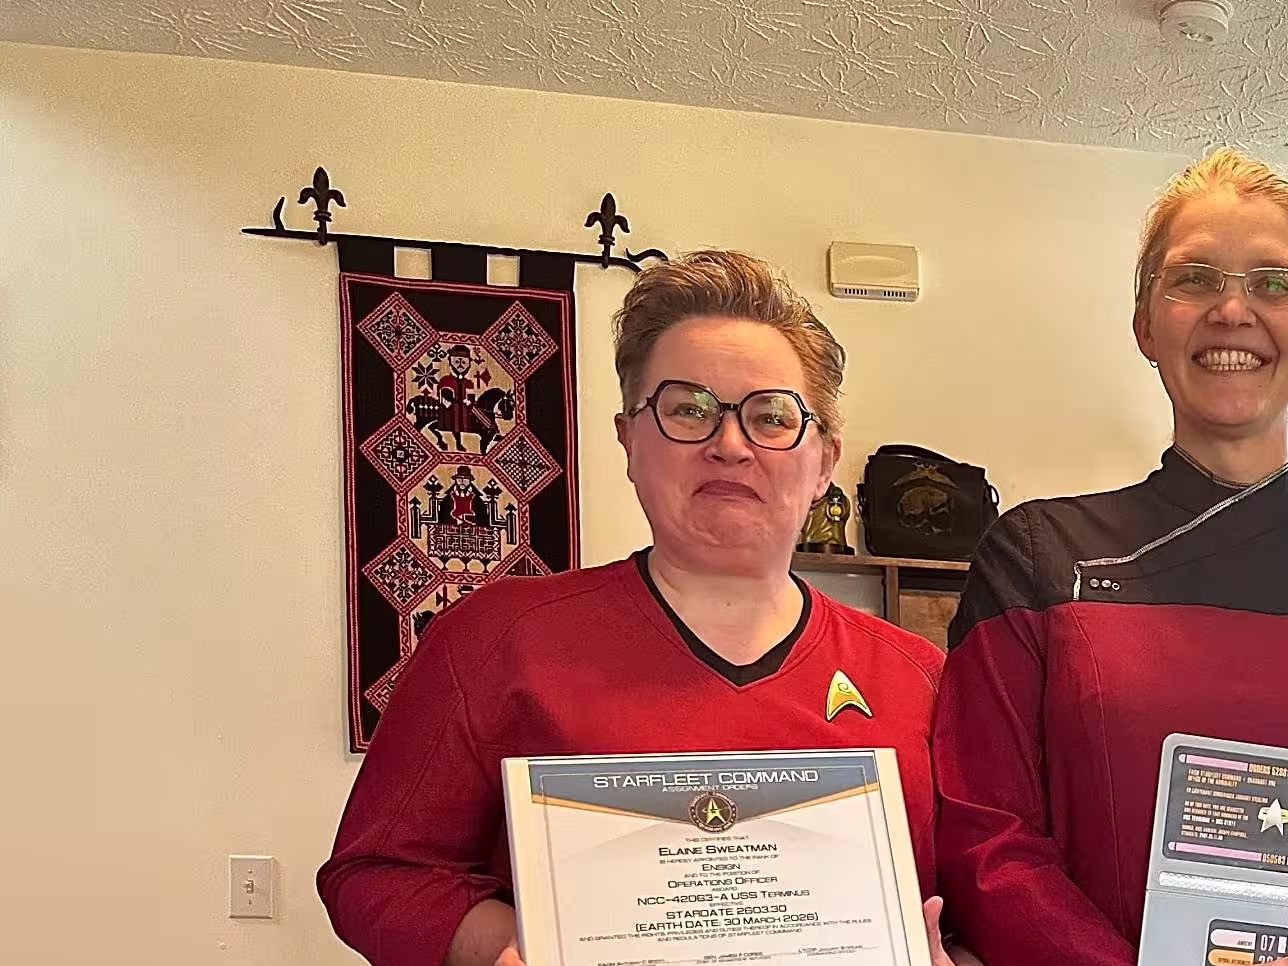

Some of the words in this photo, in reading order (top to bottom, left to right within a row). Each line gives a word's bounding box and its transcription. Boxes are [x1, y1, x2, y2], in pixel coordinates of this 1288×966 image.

[593, 773, 713, 788] STARFLEET
[719, 770, 819, 784] COMMAND
[659, 847, 703, 856] ELAINE
[705, 843, 778, 854] SWEATMAN
[702, 863, 741, 872] ENSIGN
[668, 879, 733, 889] OPERATIONS
[734, 876, 778, 885] OFFICER
[637, 893, 729, 906] NCC-42063-A
[730, 890, 757, 900] USS
[761, 889, 810, 899] TERMINUS
[666, 908, 734, 919] STARDATE
[736, 904, 787, 915] 2603.30
[723, 918, 740, 927] 30
[743, 916, 781, 926] MARCH
[783, 912, 819, 923] 2026)
[1260, 934, 1276, 952] 07
